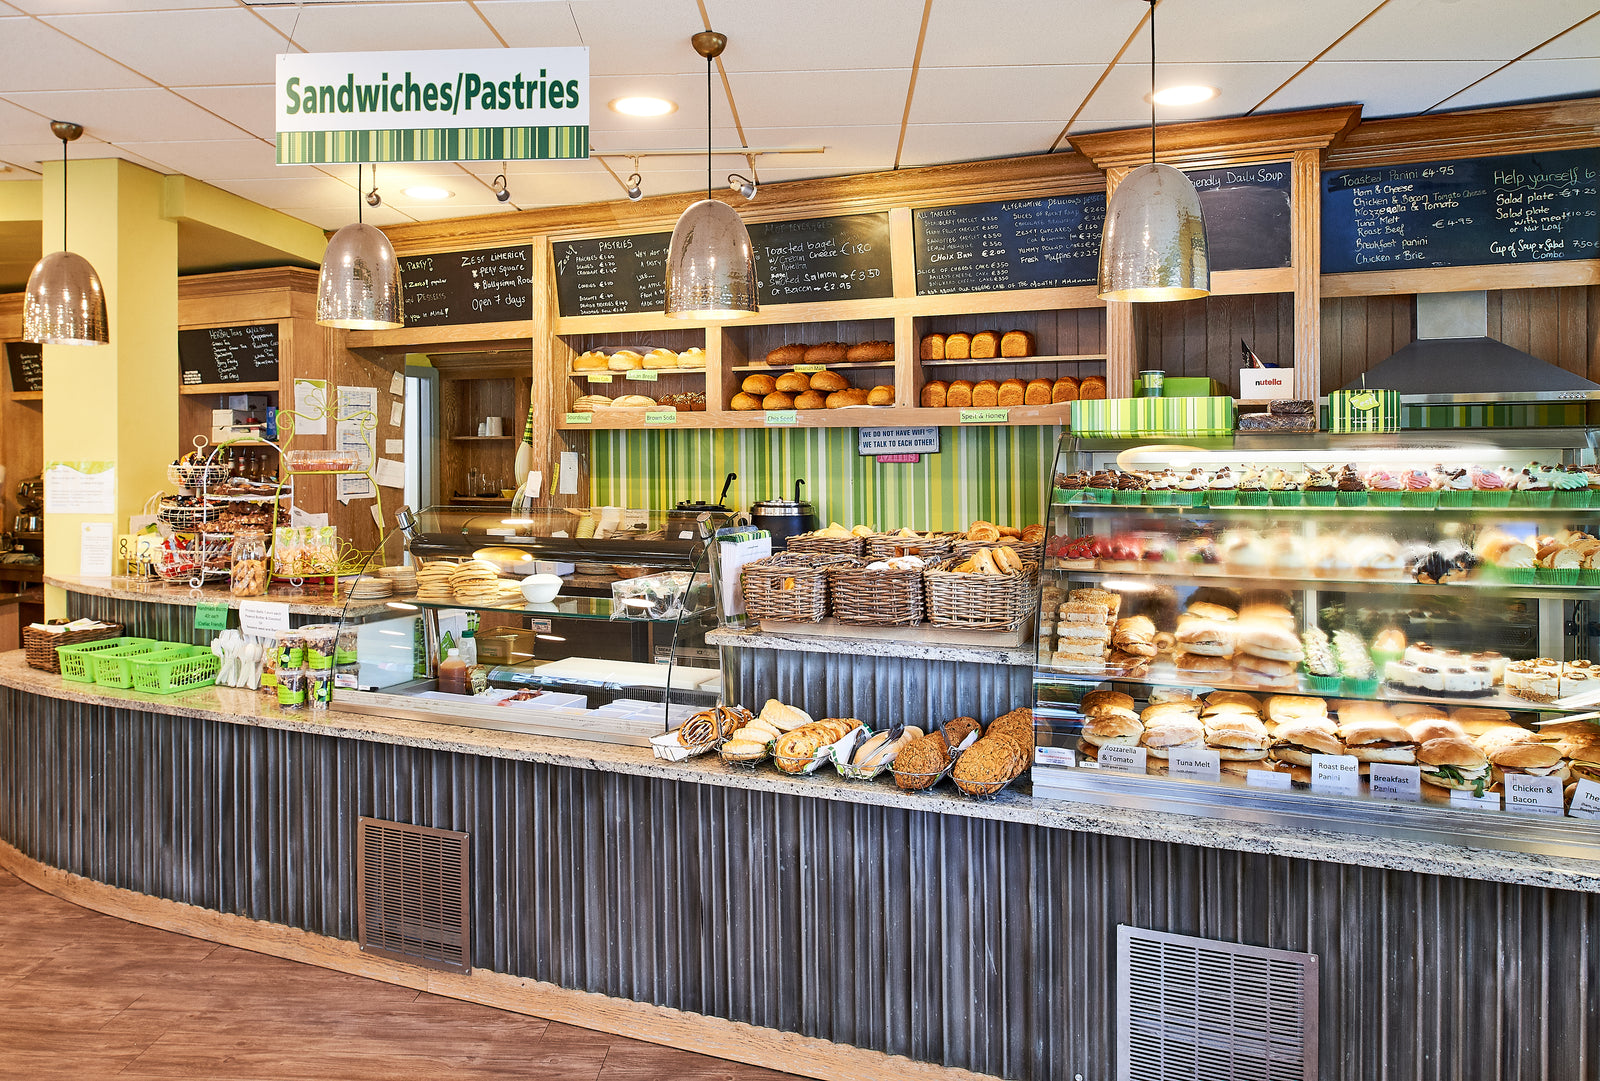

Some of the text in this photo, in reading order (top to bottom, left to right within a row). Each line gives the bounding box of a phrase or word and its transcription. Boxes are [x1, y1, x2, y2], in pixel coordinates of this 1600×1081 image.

[286, 69, 579, 115] Sandwiches/Pastries
[1226, 168, 1283, 183] Daily Soup
[1339, 171, 1382, 187] Toasted
[1389, 169, 1418, 181] Panini
[1494, 166, 1596, 190] Help yourself to
[1353, 188, 1373, 197] Ham
[1383, 184, 1414, 194] Cheese
[1353, 197, 1388, 207] Chicken
[1433, 191, 1461, 200] Tomato
[1422, 199, 1459, 211] Tomato
[1496, 193, 1523, 206] Salad
[1527, 192, 1554, 205] plate
[1495, 205, 1550, 220] Salad plate
[1514, 216, 1538, 226] with
[1540, 211, 1566, 221] meat
[1355, 218, 1375, 227] Tuna
[1379, 216, 1401, 225] Melt
[1542, 221, 1564, 233] Loaf
[1357, 224, 1405, 237] Roast Beef
[599, 239, 633, 251] PASTRIES
[765, 238, 836, 257] Toasted bagel
[1490, 241, 1506, 257] Cup
[1508, 242, 1517, 258] of
[1517, 239, 1537, 252] Soup
[1544, 239, 1564, 251] Salad
[461, 250, 527, 267] ZEST LIMERICK
[779, 255, 805, 264] Cream
[1355, 250, 1426, 265] Chicken Brie
[1532, 251, 1565, 260] Combo
[480, 264, 525, 277] PERY Square
[769, 271, 838, 287] Smoked Salmon
[784, 282, 852, 295] Bacon €2.95
[471, 293, 526, 312] Open 7 days
[1254, 378, 1282, 387] nutella
[985, 412, 1006, 420] Honey
[873, 440, 887, 448] TALK
[897, 439, 912, 447] EACH
[914, 438, 935, 446] OTHER!
[119, 538, 128, 555] 8
[140, 540, 151, 558] 2
[1109, 755, 1134, 764] Tomato
[1176, 759, 1210, 768] Tuna Melt
[1318, 762, 1356, 772] Roast Beef
[1318, 773, 1341, 782] Panini
[1373, 775, 1409, 784] Breakfast
[1373, 785, 1397, 794] Panini
[1512, 784, 1553, 794] Chicken &
[1512, 795, 1538, 804] Bacon
[1585, 791, 1600, 802] The
